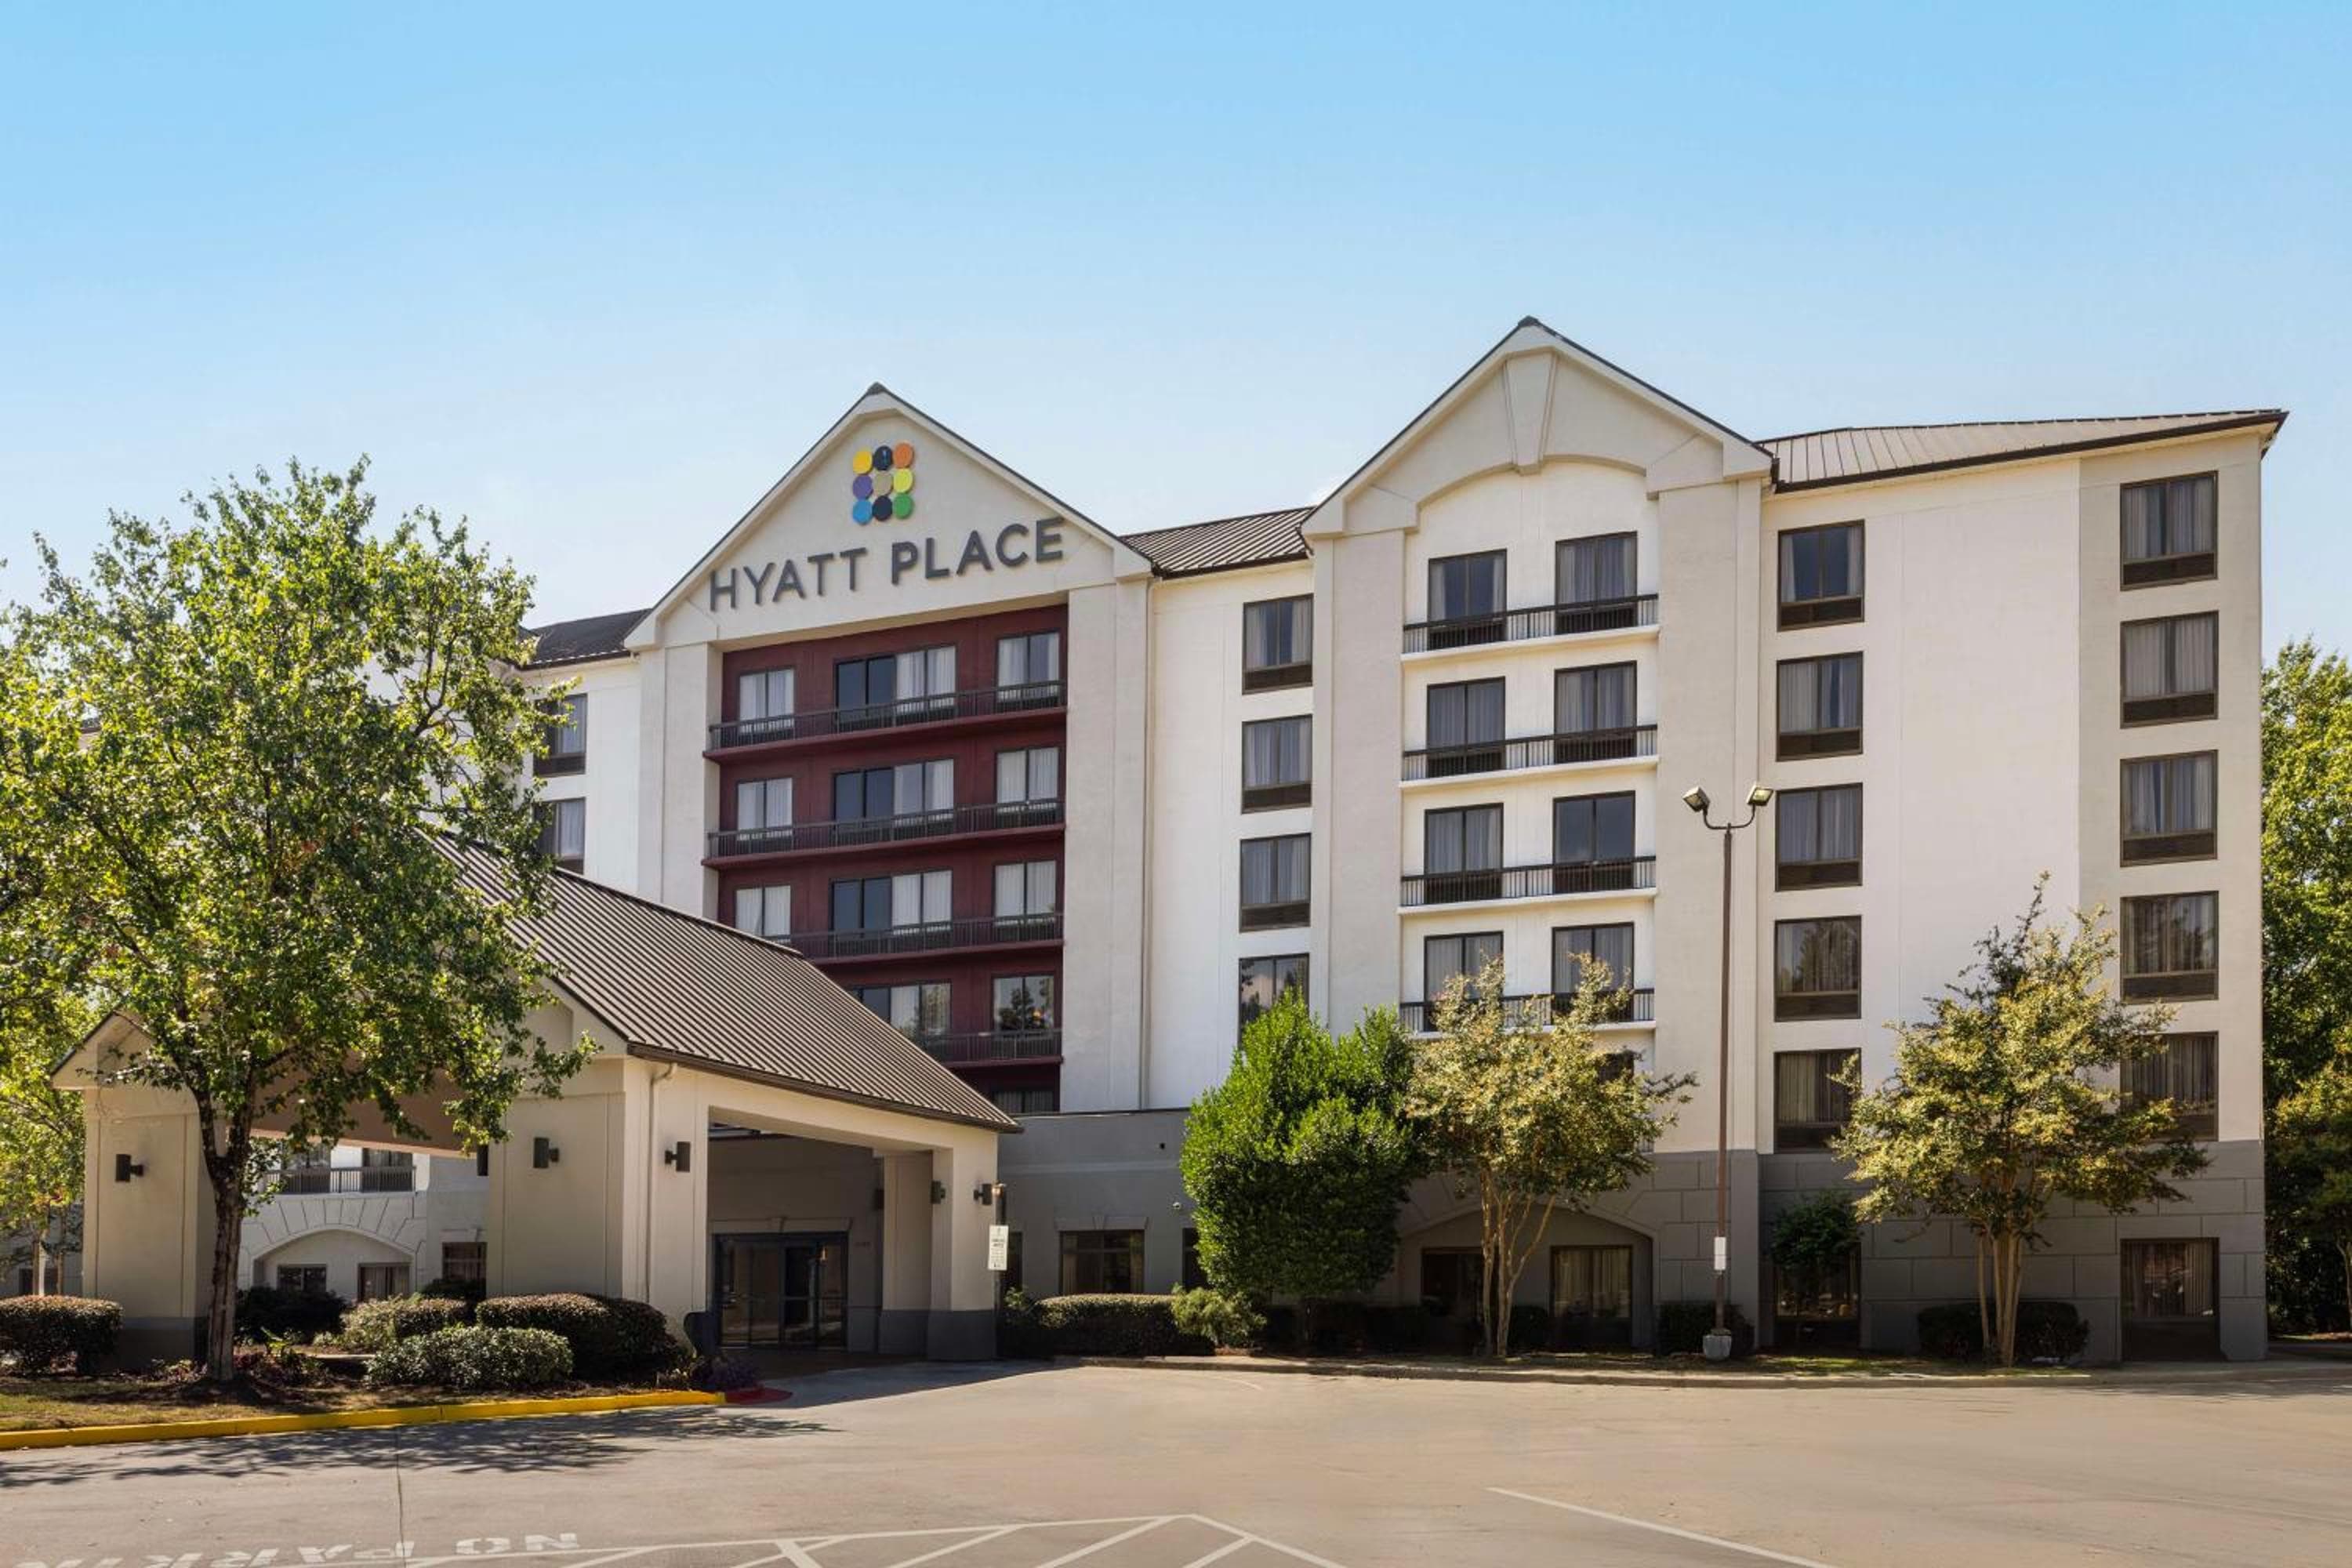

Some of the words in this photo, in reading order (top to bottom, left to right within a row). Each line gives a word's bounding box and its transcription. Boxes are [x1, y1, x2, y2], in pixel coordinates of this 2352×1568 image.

[709, 546, 869, 612] HYATT
[891, 516, 1065, 586] PLACE
[454, 1533, 579, 1555] NO
